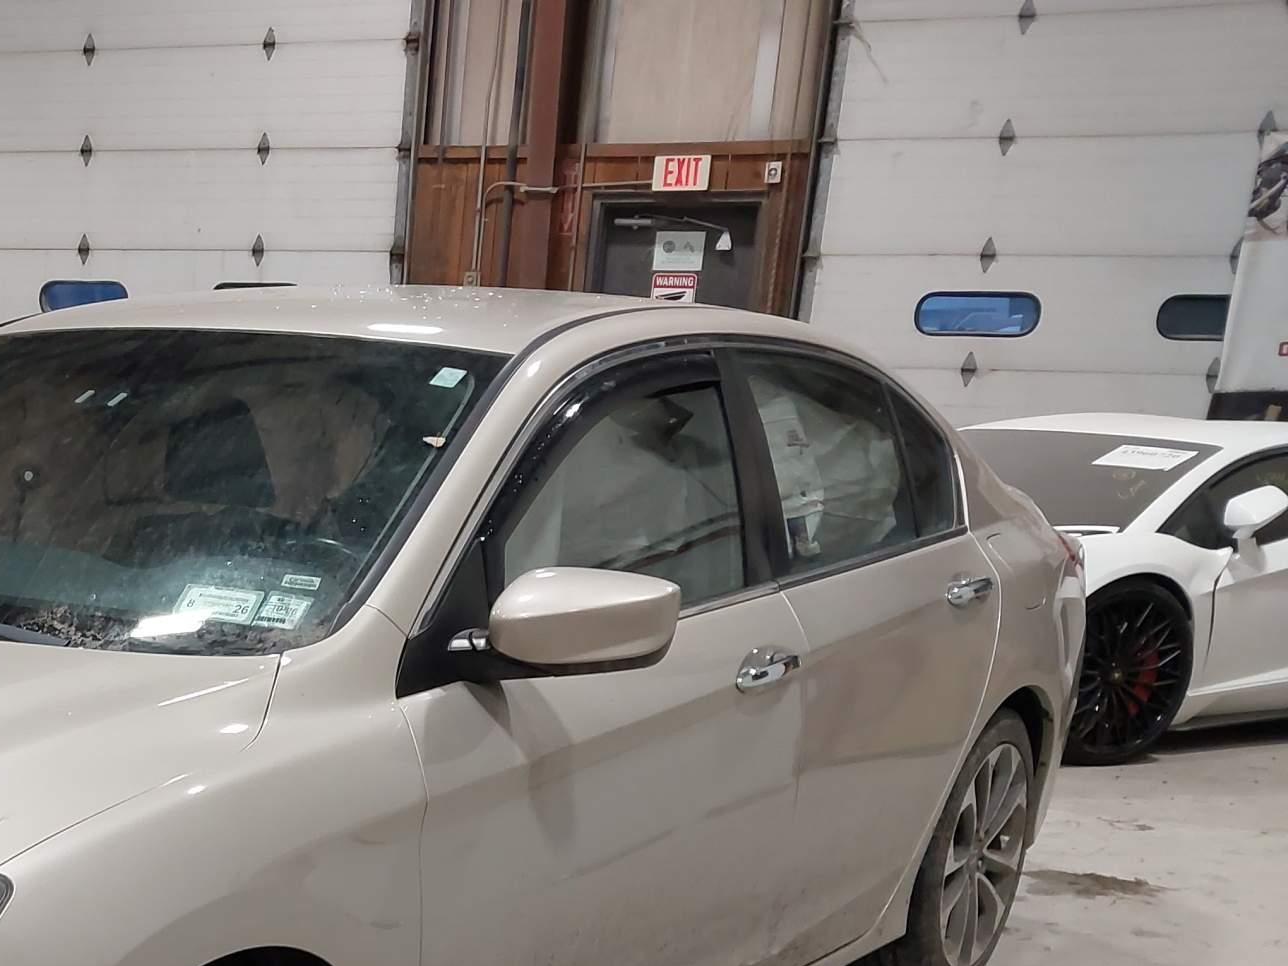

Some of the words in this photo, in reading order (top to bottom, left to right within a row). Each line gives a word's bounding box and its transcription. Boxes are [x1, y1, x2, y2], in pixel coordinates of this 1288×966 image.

[663, 157, 703, 188] EXIT
[656, 276, 694, 287] WARNING
[232, 604, 250, 615] 26
